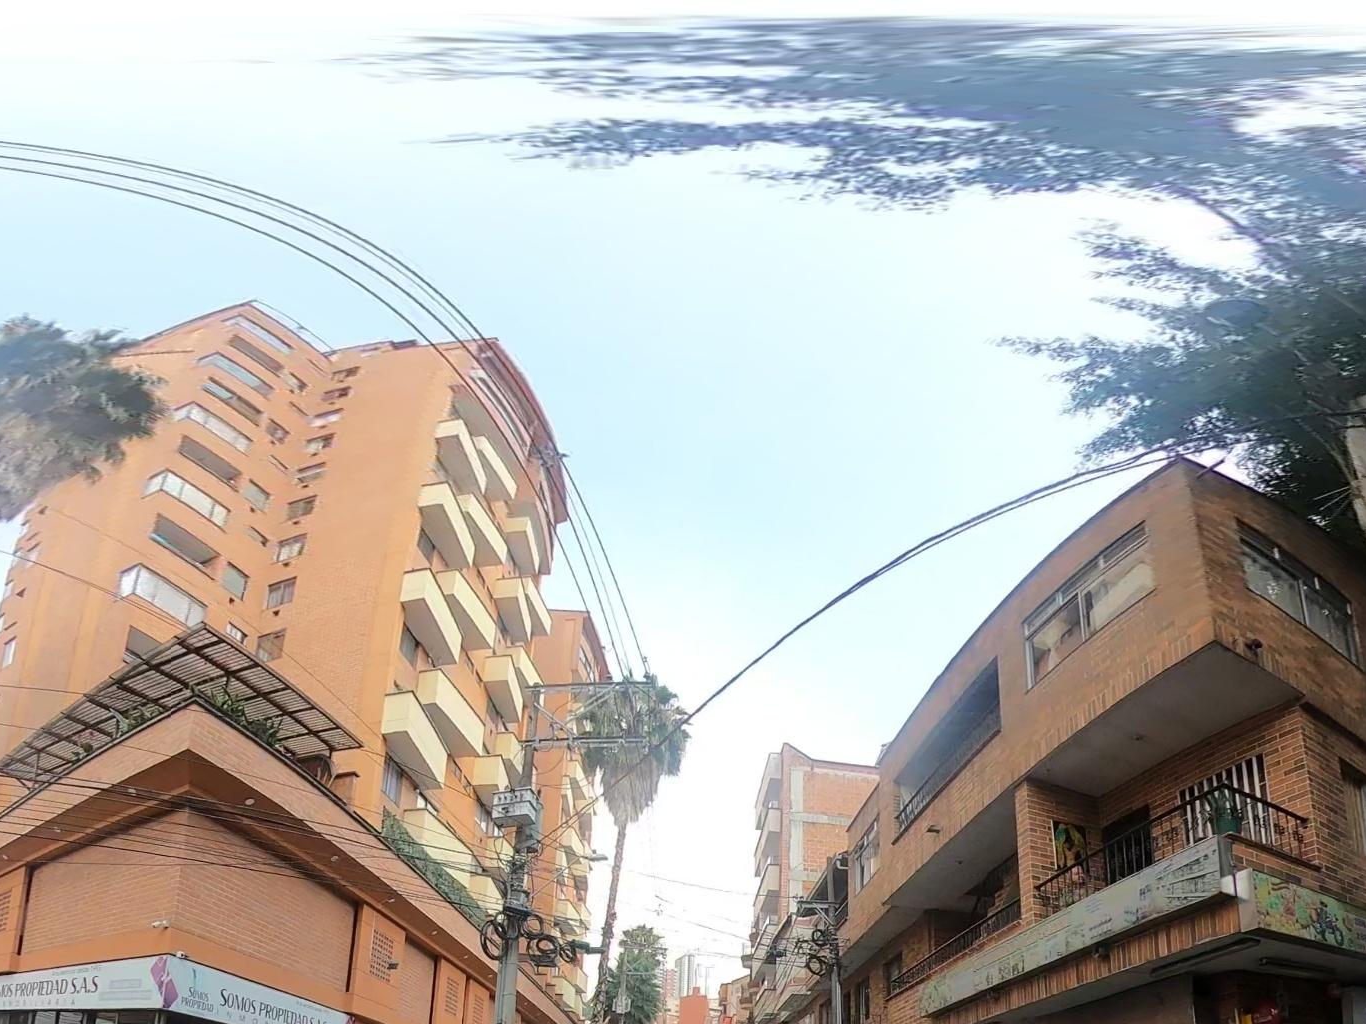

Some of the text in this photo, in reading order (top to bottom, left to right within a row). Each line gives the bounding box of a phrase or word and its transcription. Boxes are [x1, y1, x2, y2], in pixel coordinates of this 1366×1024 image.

[15, 979, 68, 998] PROPIEDAD
[70, 975, 99, 995] S.A.S
[220, 988, 257, 1015] SOMOS
